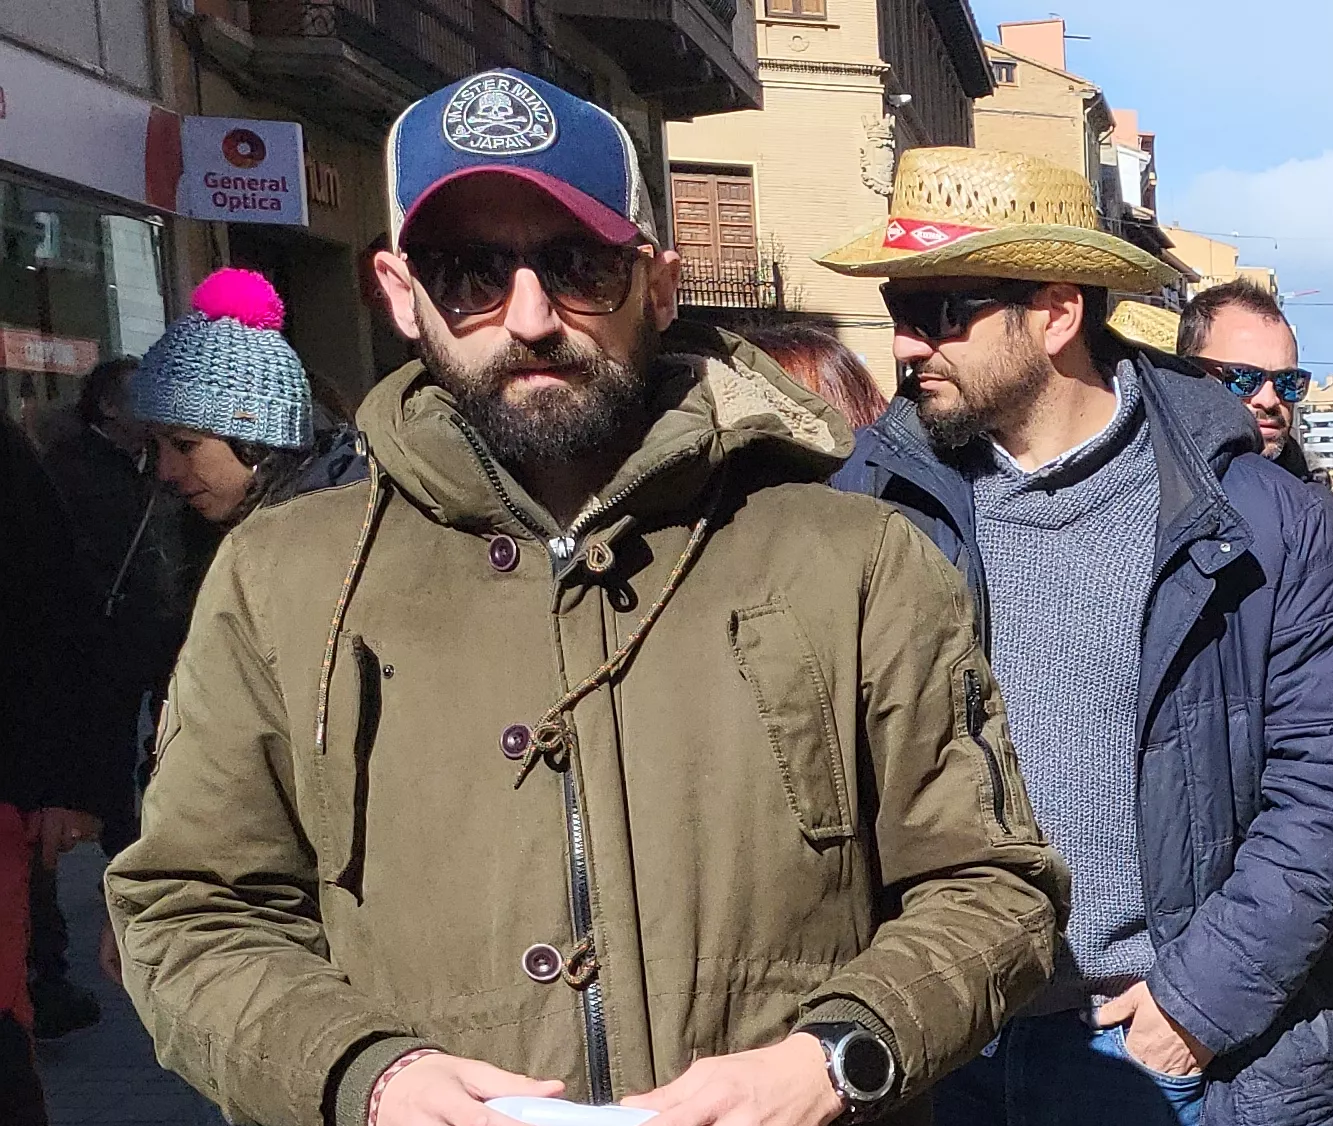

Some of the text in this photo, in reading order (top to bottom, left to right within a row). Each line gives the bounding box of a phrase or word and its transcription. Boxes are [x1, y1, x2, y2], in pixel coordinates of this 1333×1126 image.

[447, 78, 550, 123] MASTERMIND
[469, 134, 532, 150] JAPAN
[203, 171, 290, 193] General
[211, 191, 282, 213] Optica
